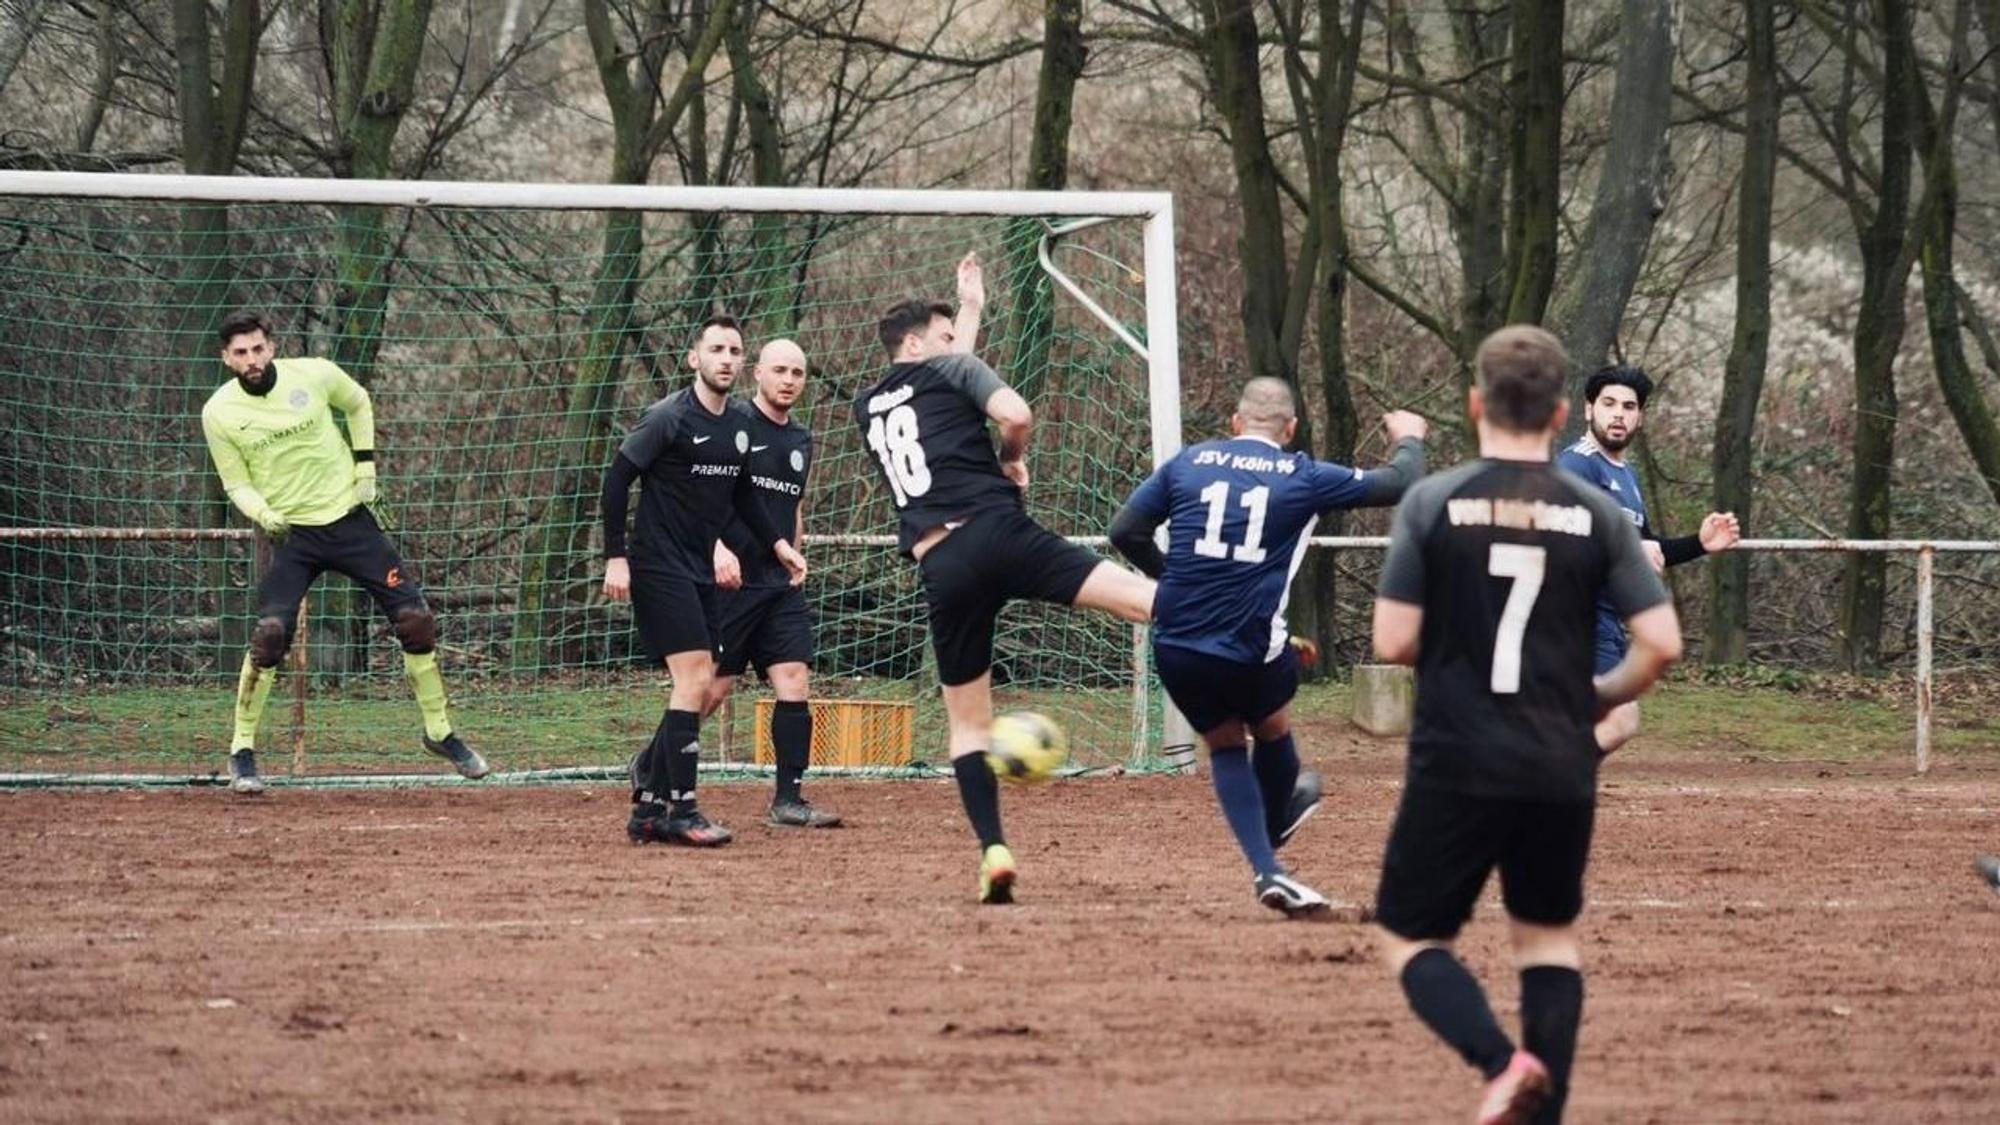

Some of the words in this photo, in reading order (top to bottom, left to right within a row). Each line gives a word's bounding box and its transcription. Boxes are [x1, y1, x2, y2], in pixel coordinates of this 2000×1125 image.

[690, 463, 742, 477] PREMATC
[867, 404, 932, 508] 18
[1194, 450, 1231, 466] JSV
[1232, 455, 1274, 472] Köln
[1194, 480, 1270, 564] 11
[1487, 542, 1546, 694] 7
